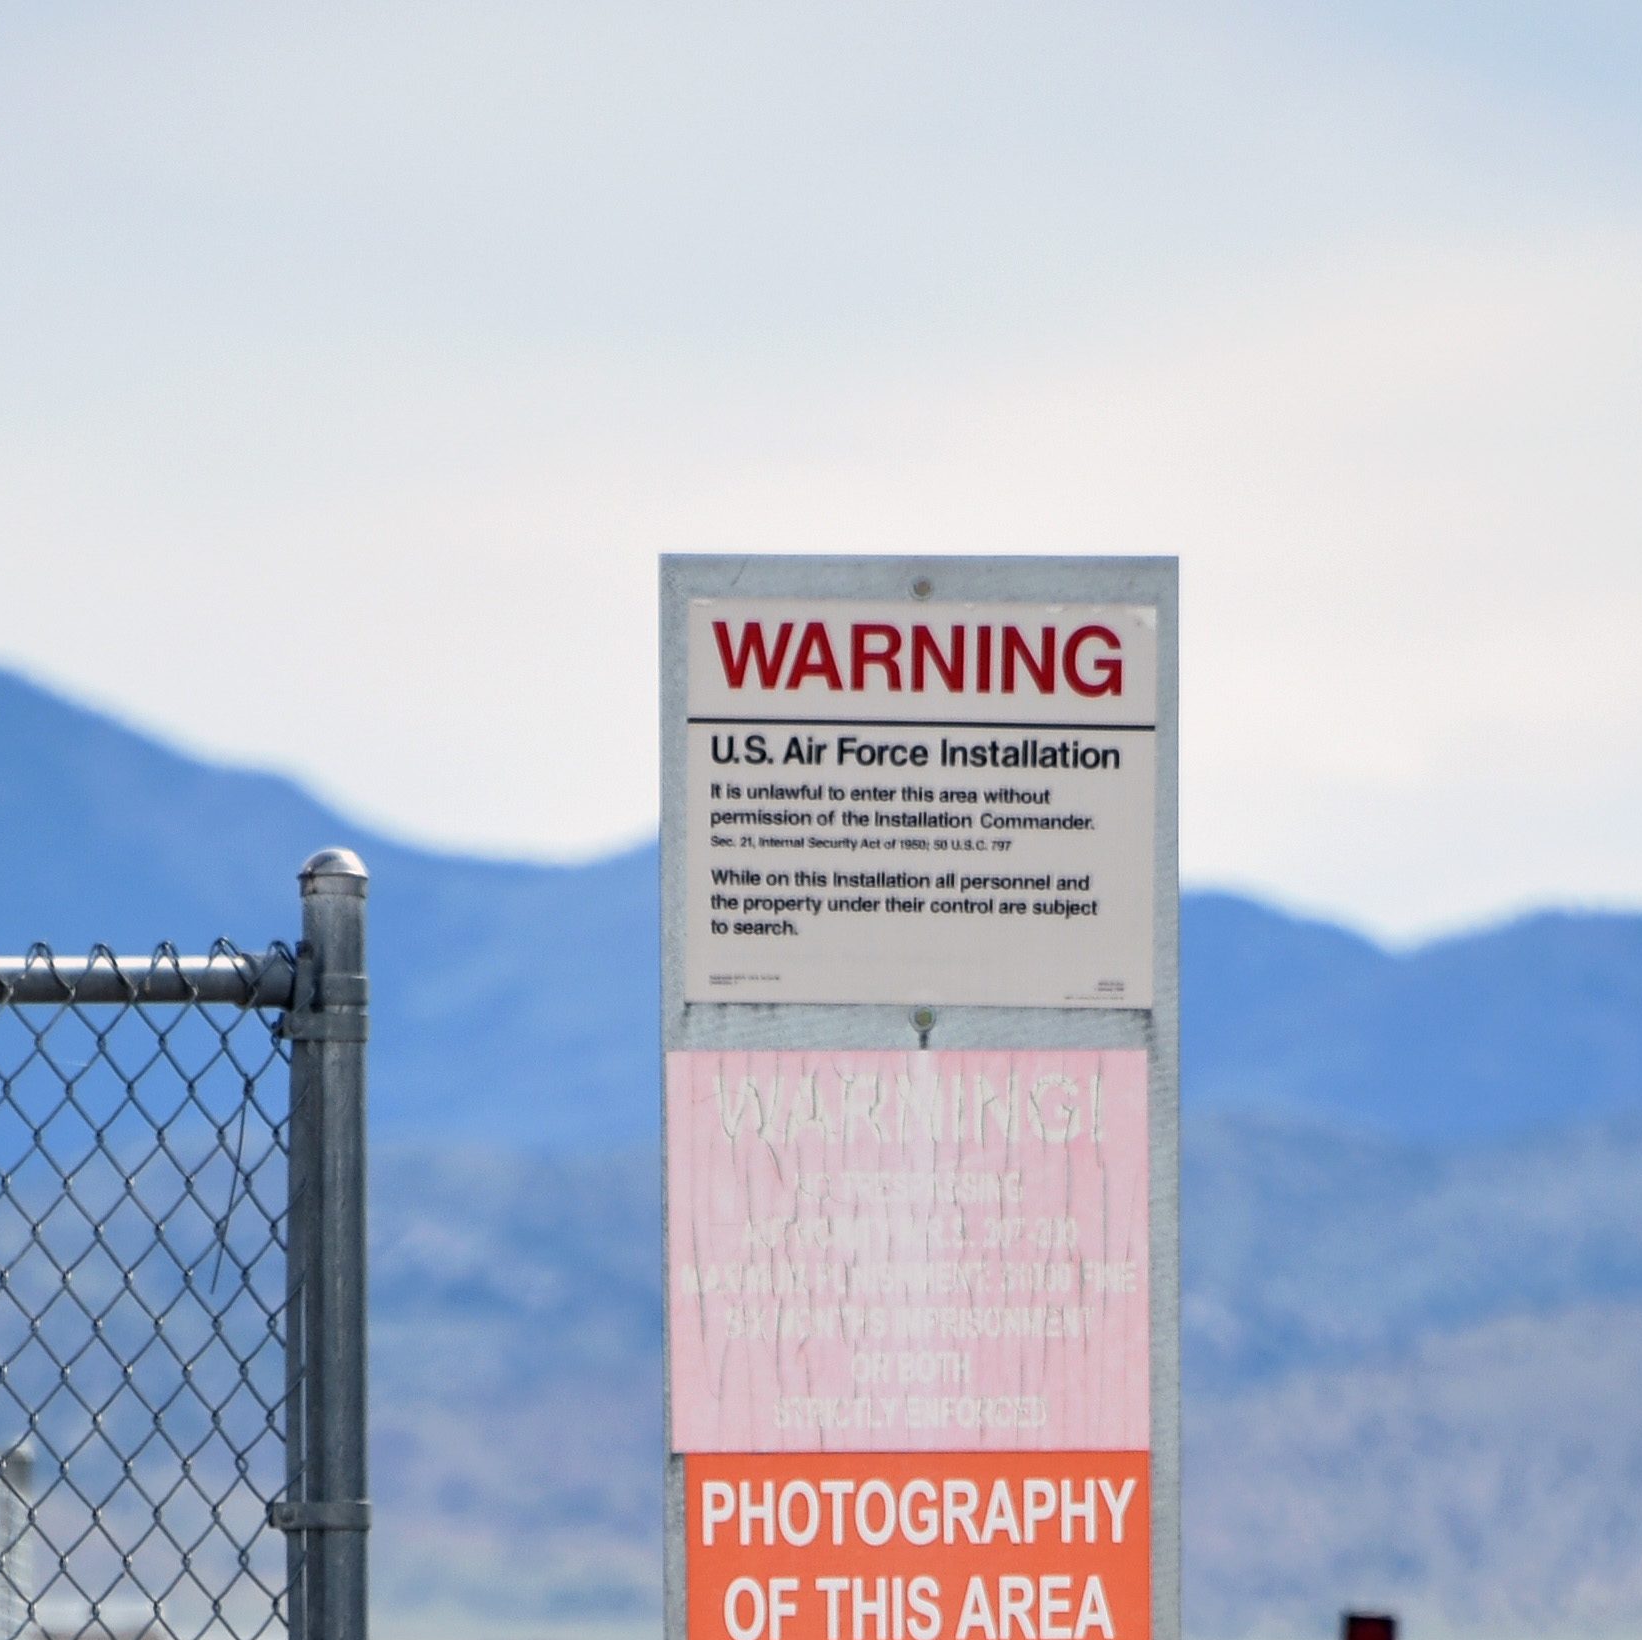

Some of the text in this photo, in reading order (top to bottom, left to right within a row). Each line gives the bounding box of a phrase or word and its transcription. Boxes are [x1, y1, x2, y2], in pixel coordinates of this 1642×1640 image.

[711, 620, 1123, 697] WARNING
[711, 734, 1121, 770] U.S. Air Force Installation
[710, 783, 1050, 805] It is unlawful to enter this area without
[710, 810, 1095, 830] permission of the Installation Commander.
[711, 836, 736, 848] Sec.
[740, 836, 755, 849] 21,
[759, 837, 804, 849] Internal
[808, 837, 857, 851] Security
[860, 838, 881, 850] Act
[884, 838, 896, 850] of
[934, 839, 947, 851] 50
[992, 840, 1012, 851] 797
[711, 869, 1090, 893] While on this Installation all personnel and
[710, 894, 1098, 919] the property under their control are subject
[711, 919, 798, 936] to search.
[711, 1070, 1107, 1144] WARNING!
[726, 1308, 766, 1340] SX
[701, 1478, 1136, 1546] PHOTOGRAPHY
[955, 1575, 1114, 1640] AREA
